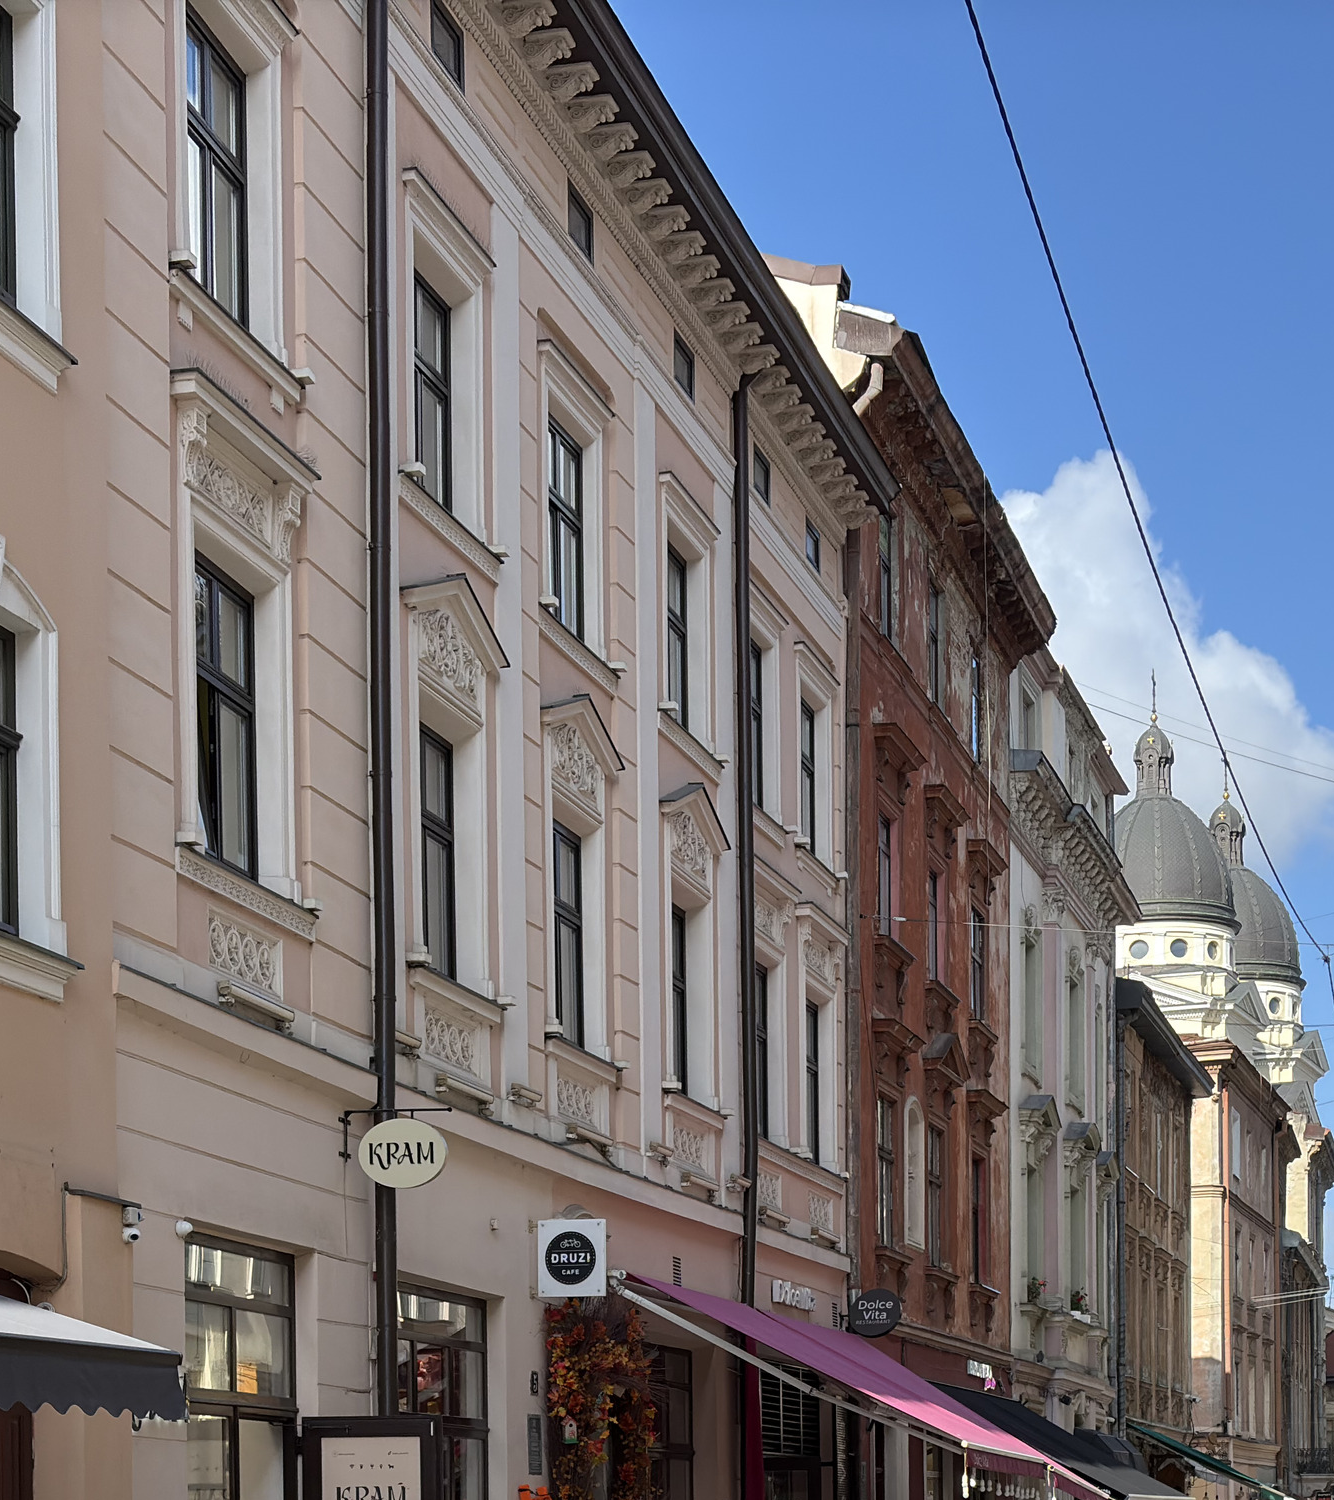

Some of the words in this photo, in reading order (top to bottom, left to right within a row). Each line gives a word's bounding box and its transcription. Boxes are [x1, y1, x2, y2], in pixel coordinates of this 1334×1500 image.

[368, 1141, 435, 1171] KRAM
[551, 1252, 591, 1264] DRUZI
[858, 1299, 894, 1311] Dolce
[862, 1310, 887, 1320] Vita
